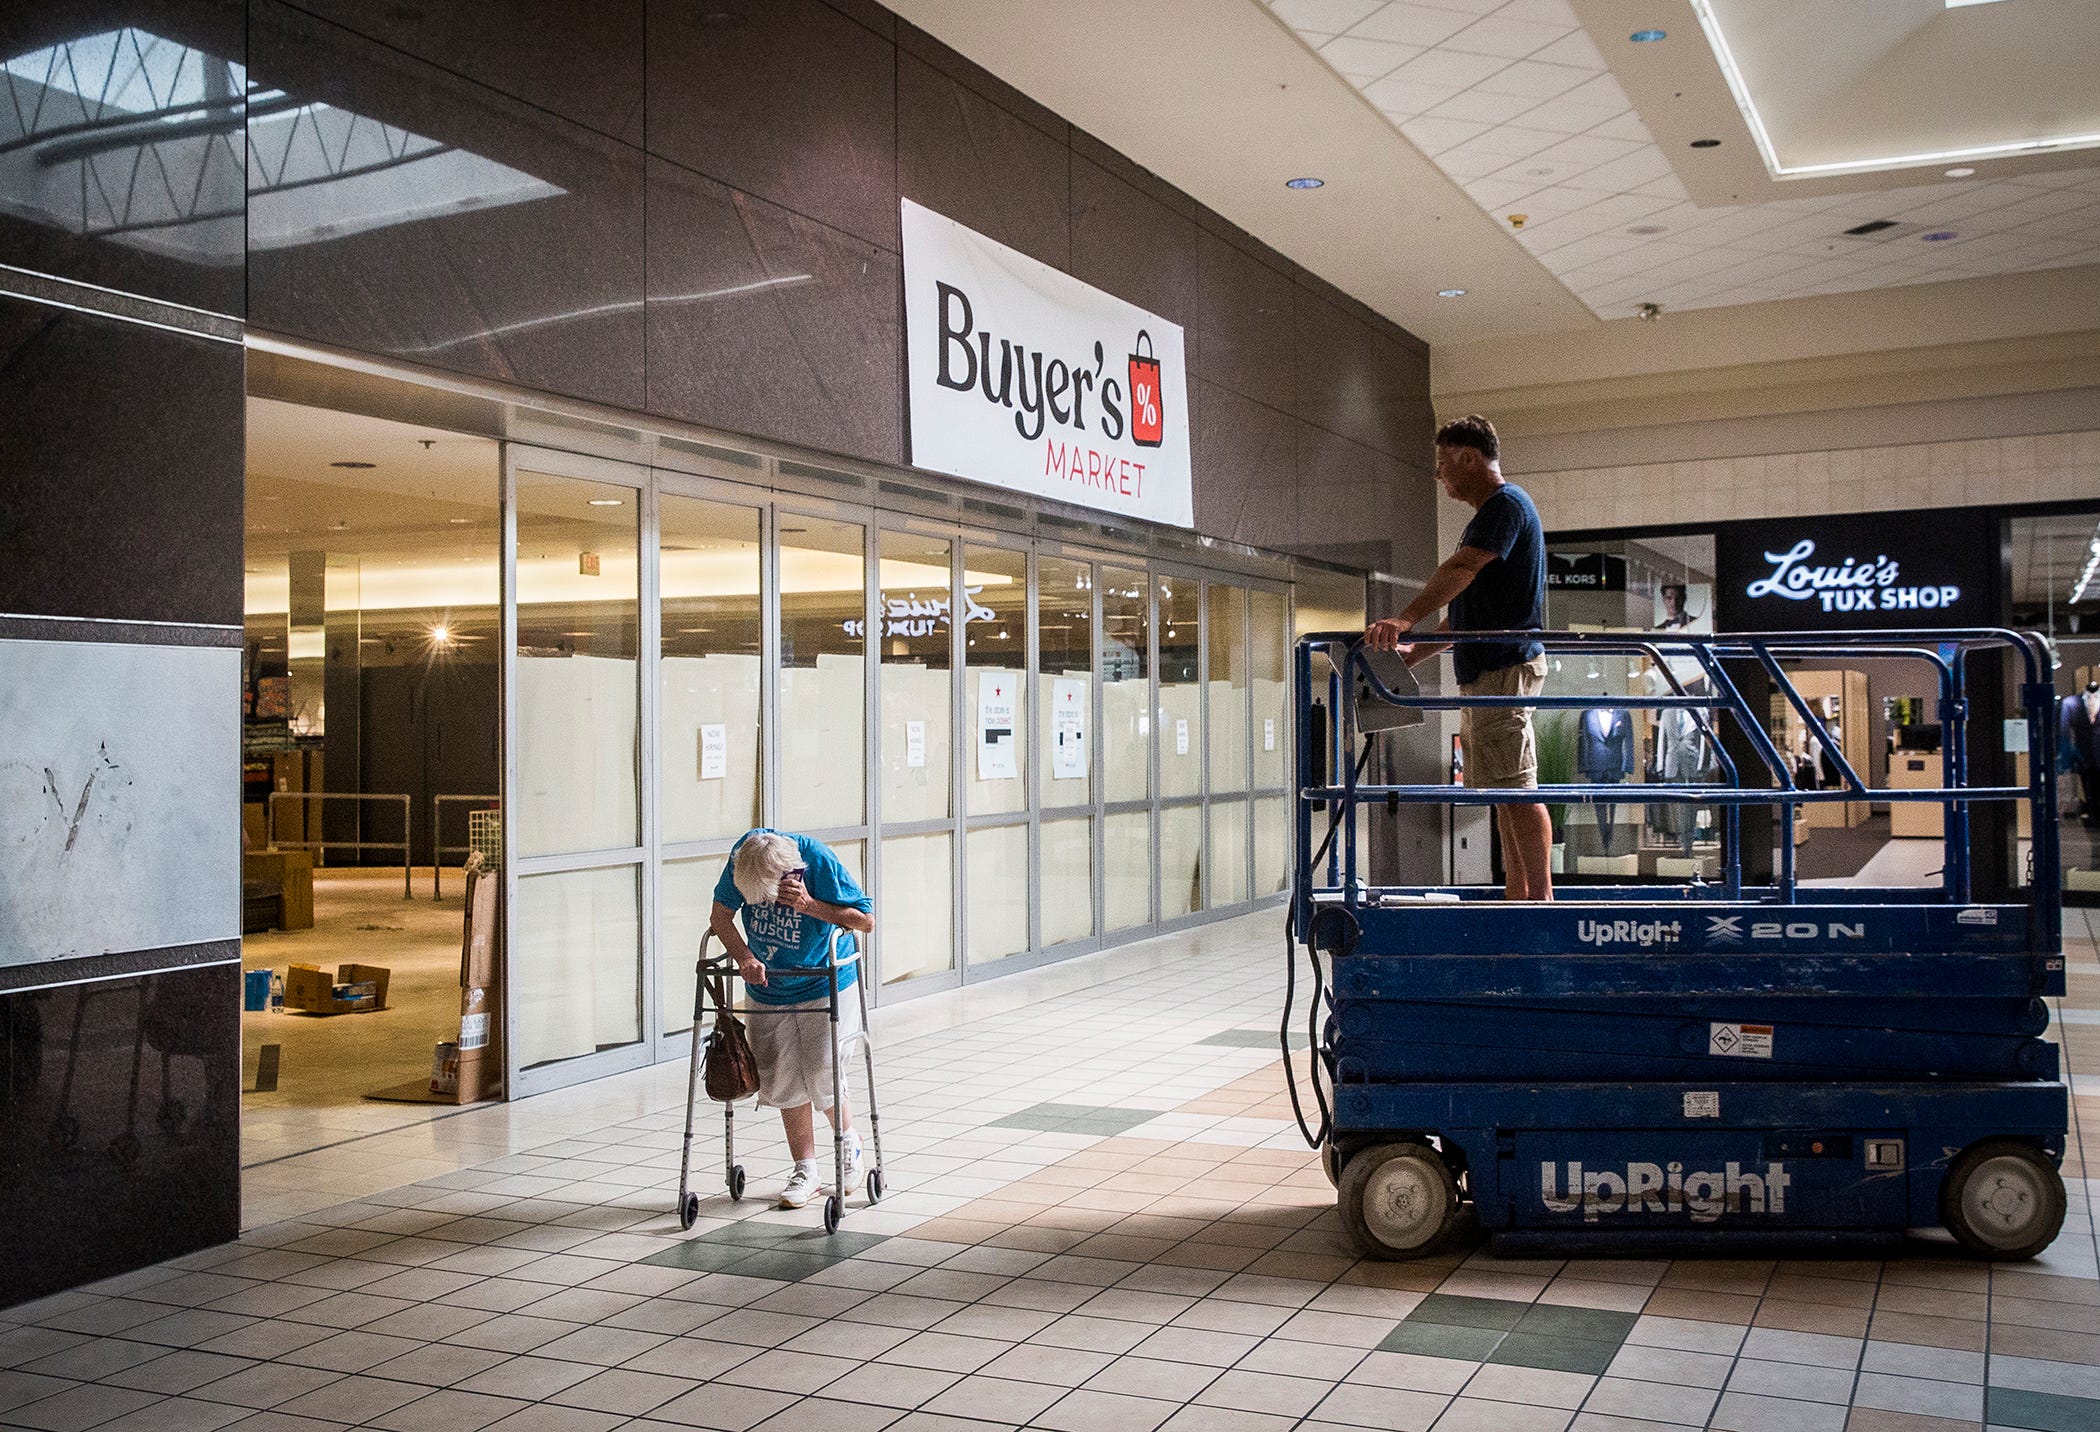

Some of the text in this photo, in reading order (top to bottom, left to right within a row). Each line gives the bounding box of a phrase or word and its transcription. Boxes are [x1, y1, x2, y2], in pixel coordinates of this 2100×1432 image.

[936, 280, 1124, 440] Buyer's
[1045, 438, 1146, 498] MARKET
[1565, 574, 1596, 584] KORS
[1747, 539, 1900, 600] Louie's
[1819, 585, 1960, 612] TUX SHOP
[750, 918, 801, 943] MUSCLE
[771, 913, 802, 929] THAT
[1578, 920, 1682, 946] UpRight
[1541, 1161, 1791, 1223] UpRight
